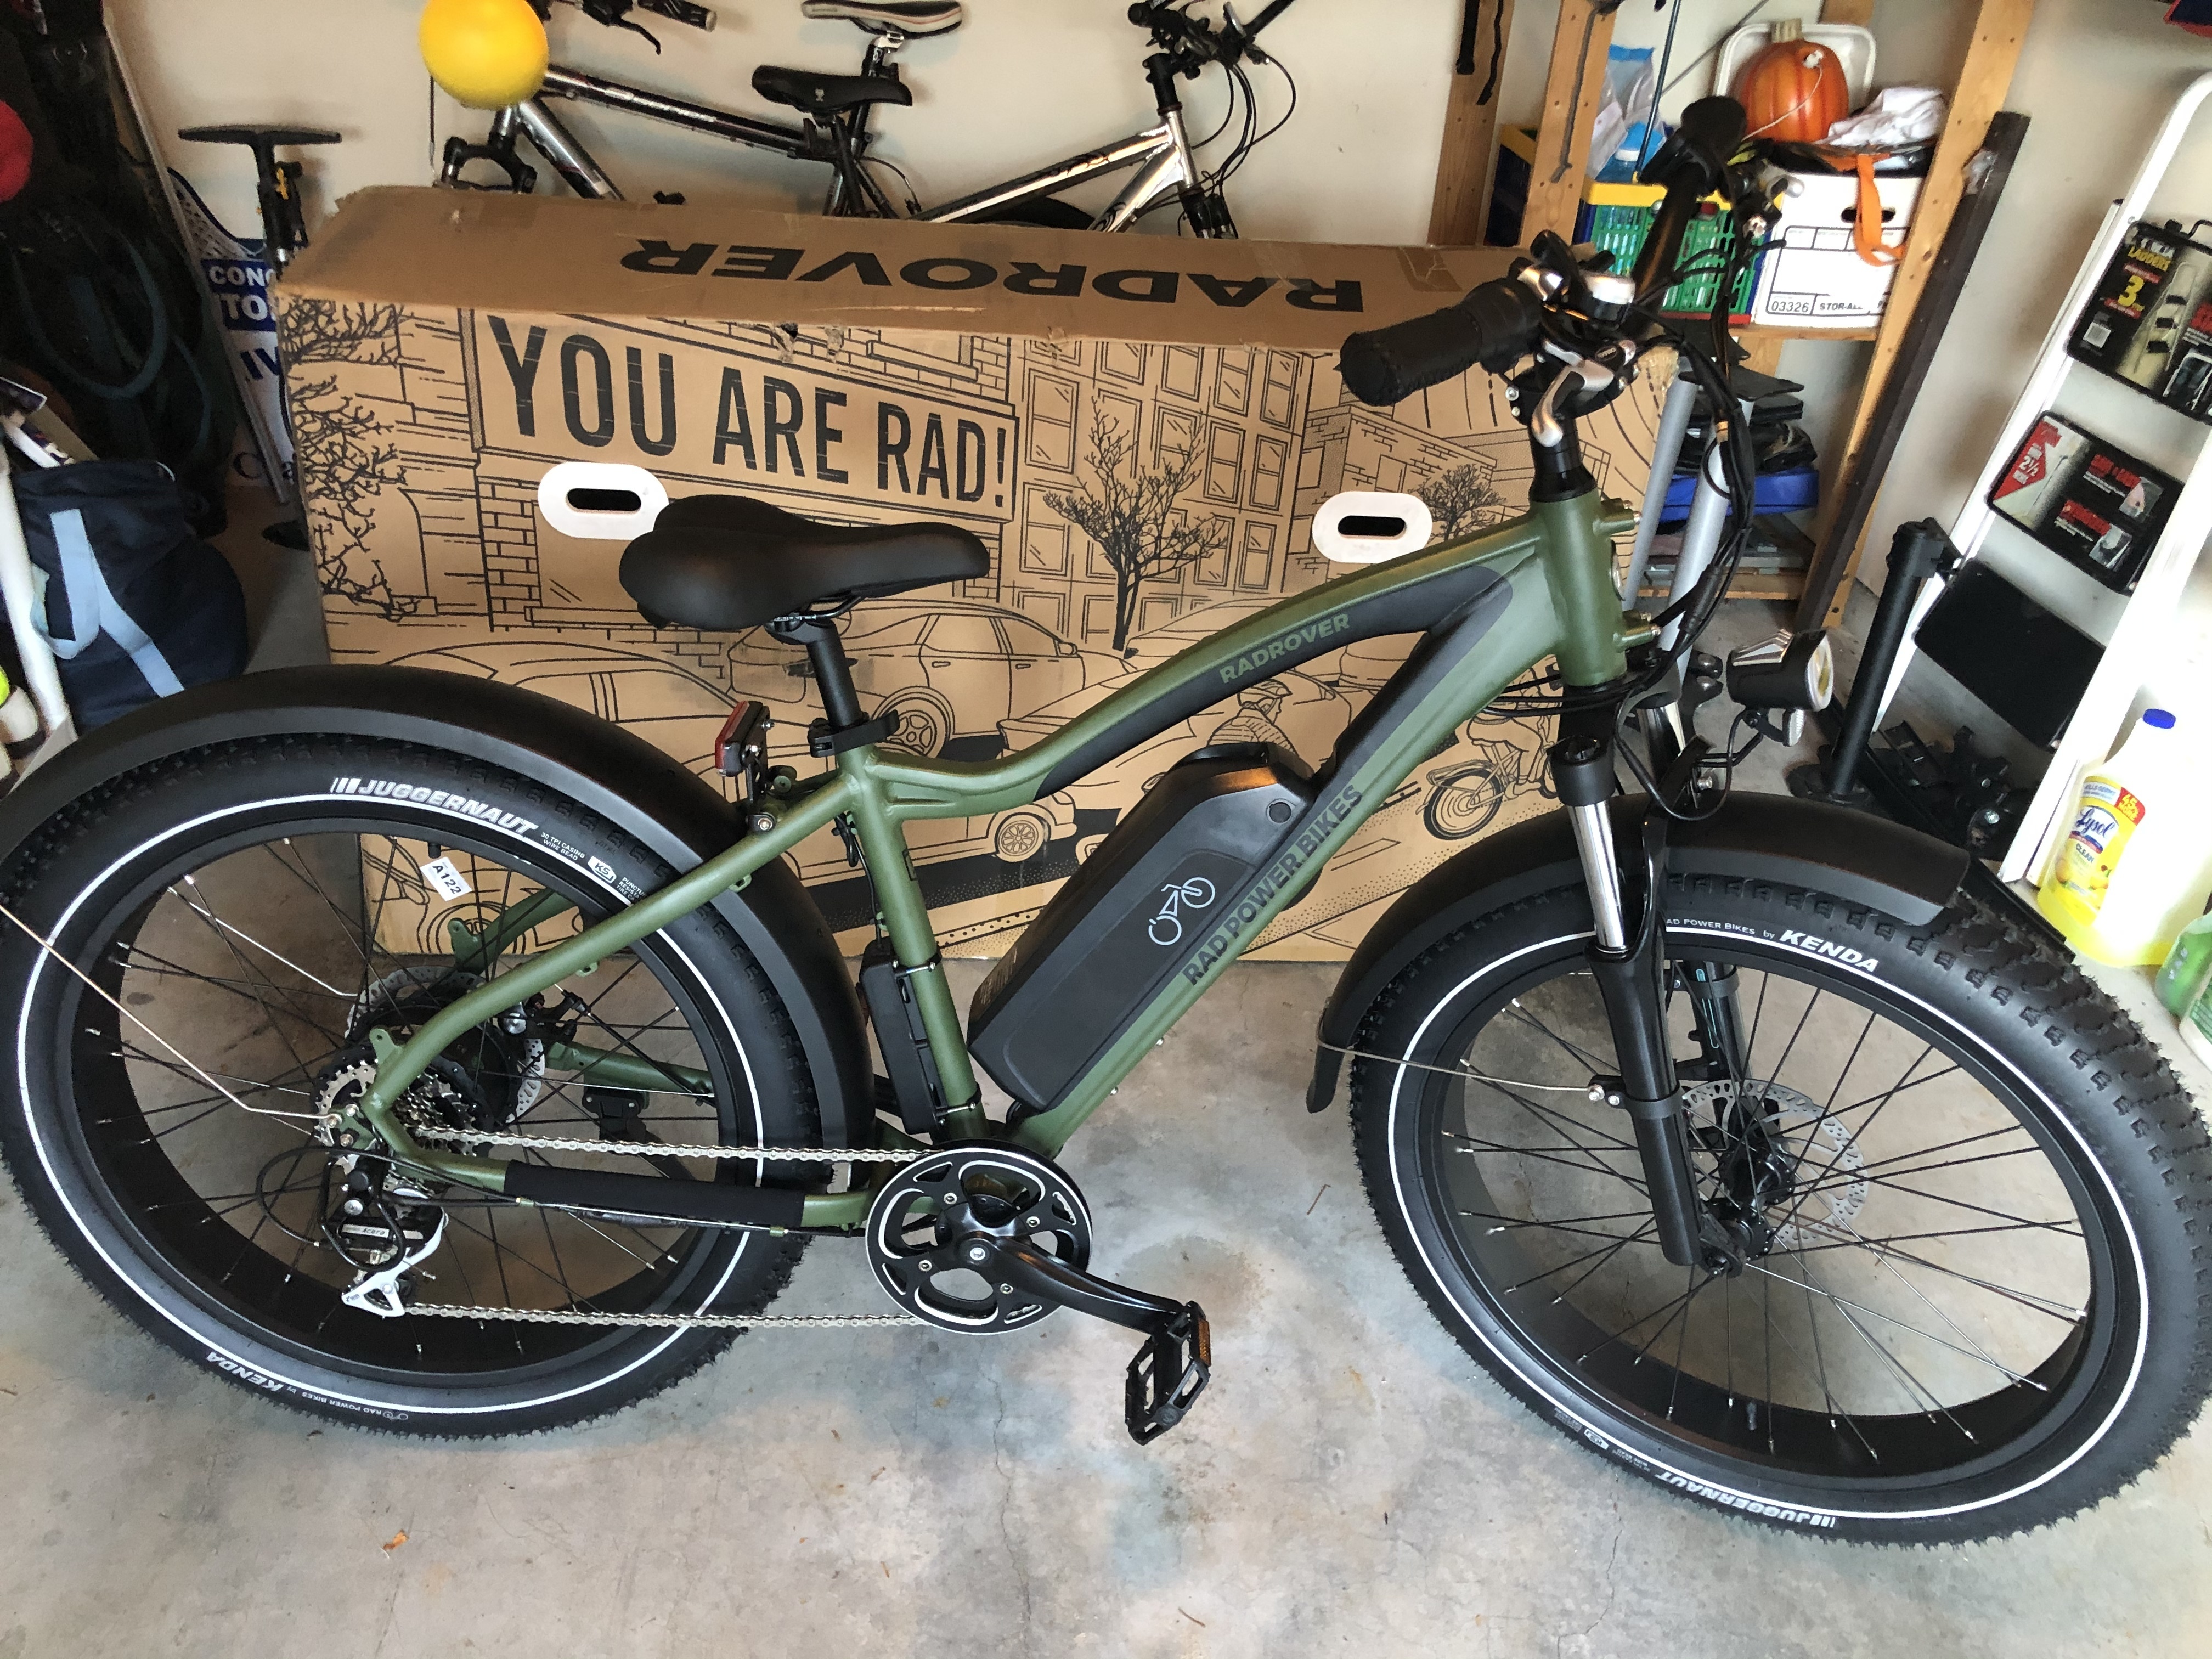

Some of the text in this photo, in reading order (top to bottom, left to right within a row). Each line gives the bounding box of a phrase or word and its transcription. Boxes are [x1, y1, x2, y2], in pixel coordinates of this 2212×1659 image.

[620, 239, 1364, 313] RADROVER
[221, 294, 276, 321] TO
[1771, 301, 1809, 313] 03326
[487, 315, 1006, 509] YOU ARE RAD!
[1219, 613, 1350, 684] RADROVER
[358, 780, 539, 834] JUGGERNAUT
[2075, 807, 2115, 838] Lysol
[543, 839, 578, 861] WIRE BEAD
[550, 836, 561, 845] TPI
[561, 841, 585, 859] CASING
[432, 865, 462, 895] A122
[595, 862, 611, 876] KS
[616, 884, 628, 898] TIRE
[619, 881, 641, 899] RESISTA
[1182, 784, 1363, 986] RAD POWER BIKES
[1683, 919, 1722, 929] POWER
[1724, 923, 1756, 935] BIKES
[1763, 930, 1775, 940] by
[1779, 929, 1878, 973] KENDA
[206, 1352, 382, 1415] RAD POWER BIKES by KENDA
